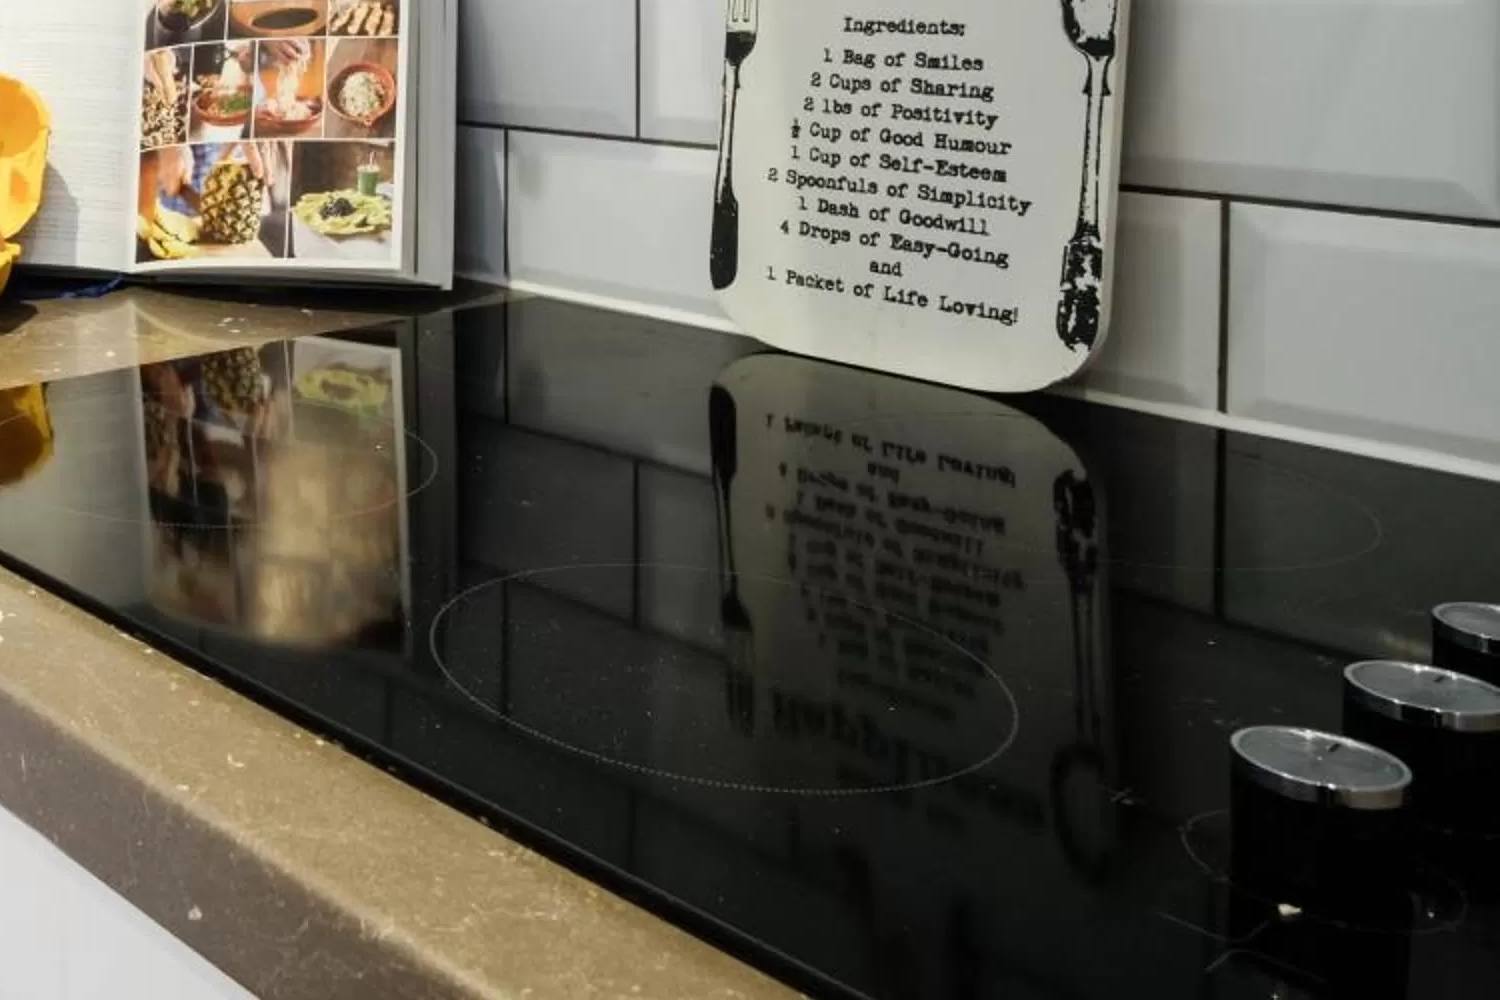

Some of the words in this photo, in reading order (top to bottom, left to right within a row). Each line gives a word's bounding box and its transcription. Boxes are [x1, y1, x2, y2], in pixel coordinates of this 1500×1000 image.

[823, 48, 832, 63] 1
[843, 49, 876, 69] Bag
[884, 52, 906, 67] of
[914, 51, 984, 71] Smiles
[810, 72, 821, 87] 2
[829, 73, 872, 94] Cups
[880, 77, 902, 93] of
[910, 77, 995, 102] Sharing
[803, 97, 814, 112] 2
[822, 99, 852, 115] lbs
[861, 102, 882, 117] of
[891, 103, 999, 130] Positivity
[809, 121, 841, 142] Cup
[850, 127, 871, 142] of
[879, 128, 924, 147] Good
[934, 133, 1012, 155] Humour
[791, 145, 800, 159] 1
[809, 147, 841, 168] Cup
[850, 152, 870, 167] of
[879, 153, 1007, 183] Self-Esteem
[767, 167, 778, 182] 2
[785, 169, 878, 195] Spoonfuls
[887, 184, 909, 199] of
[917, 184, 1032, 216] Simplicity
[798, 196, 808, 211] 1
[817, 198, 860, 219] Dash
[869, 207, 890, 223] of
[899, 208, 990, 236] Goodwill
[779, 220, 790, 235] 4
[799, 221, 851, 245] Drops
[859, 232, 881, 248] of
[890, 233, 1010, 270] Easy-Going
[869, 259, 903, 277] and
[767, 265, 776, 281] 1
[786, 269, 845, 293] Packet
[853, 283, 875, 299] of
[883, 285, 929, 308] Life
[938, 295, 1019, 326] Loving!
